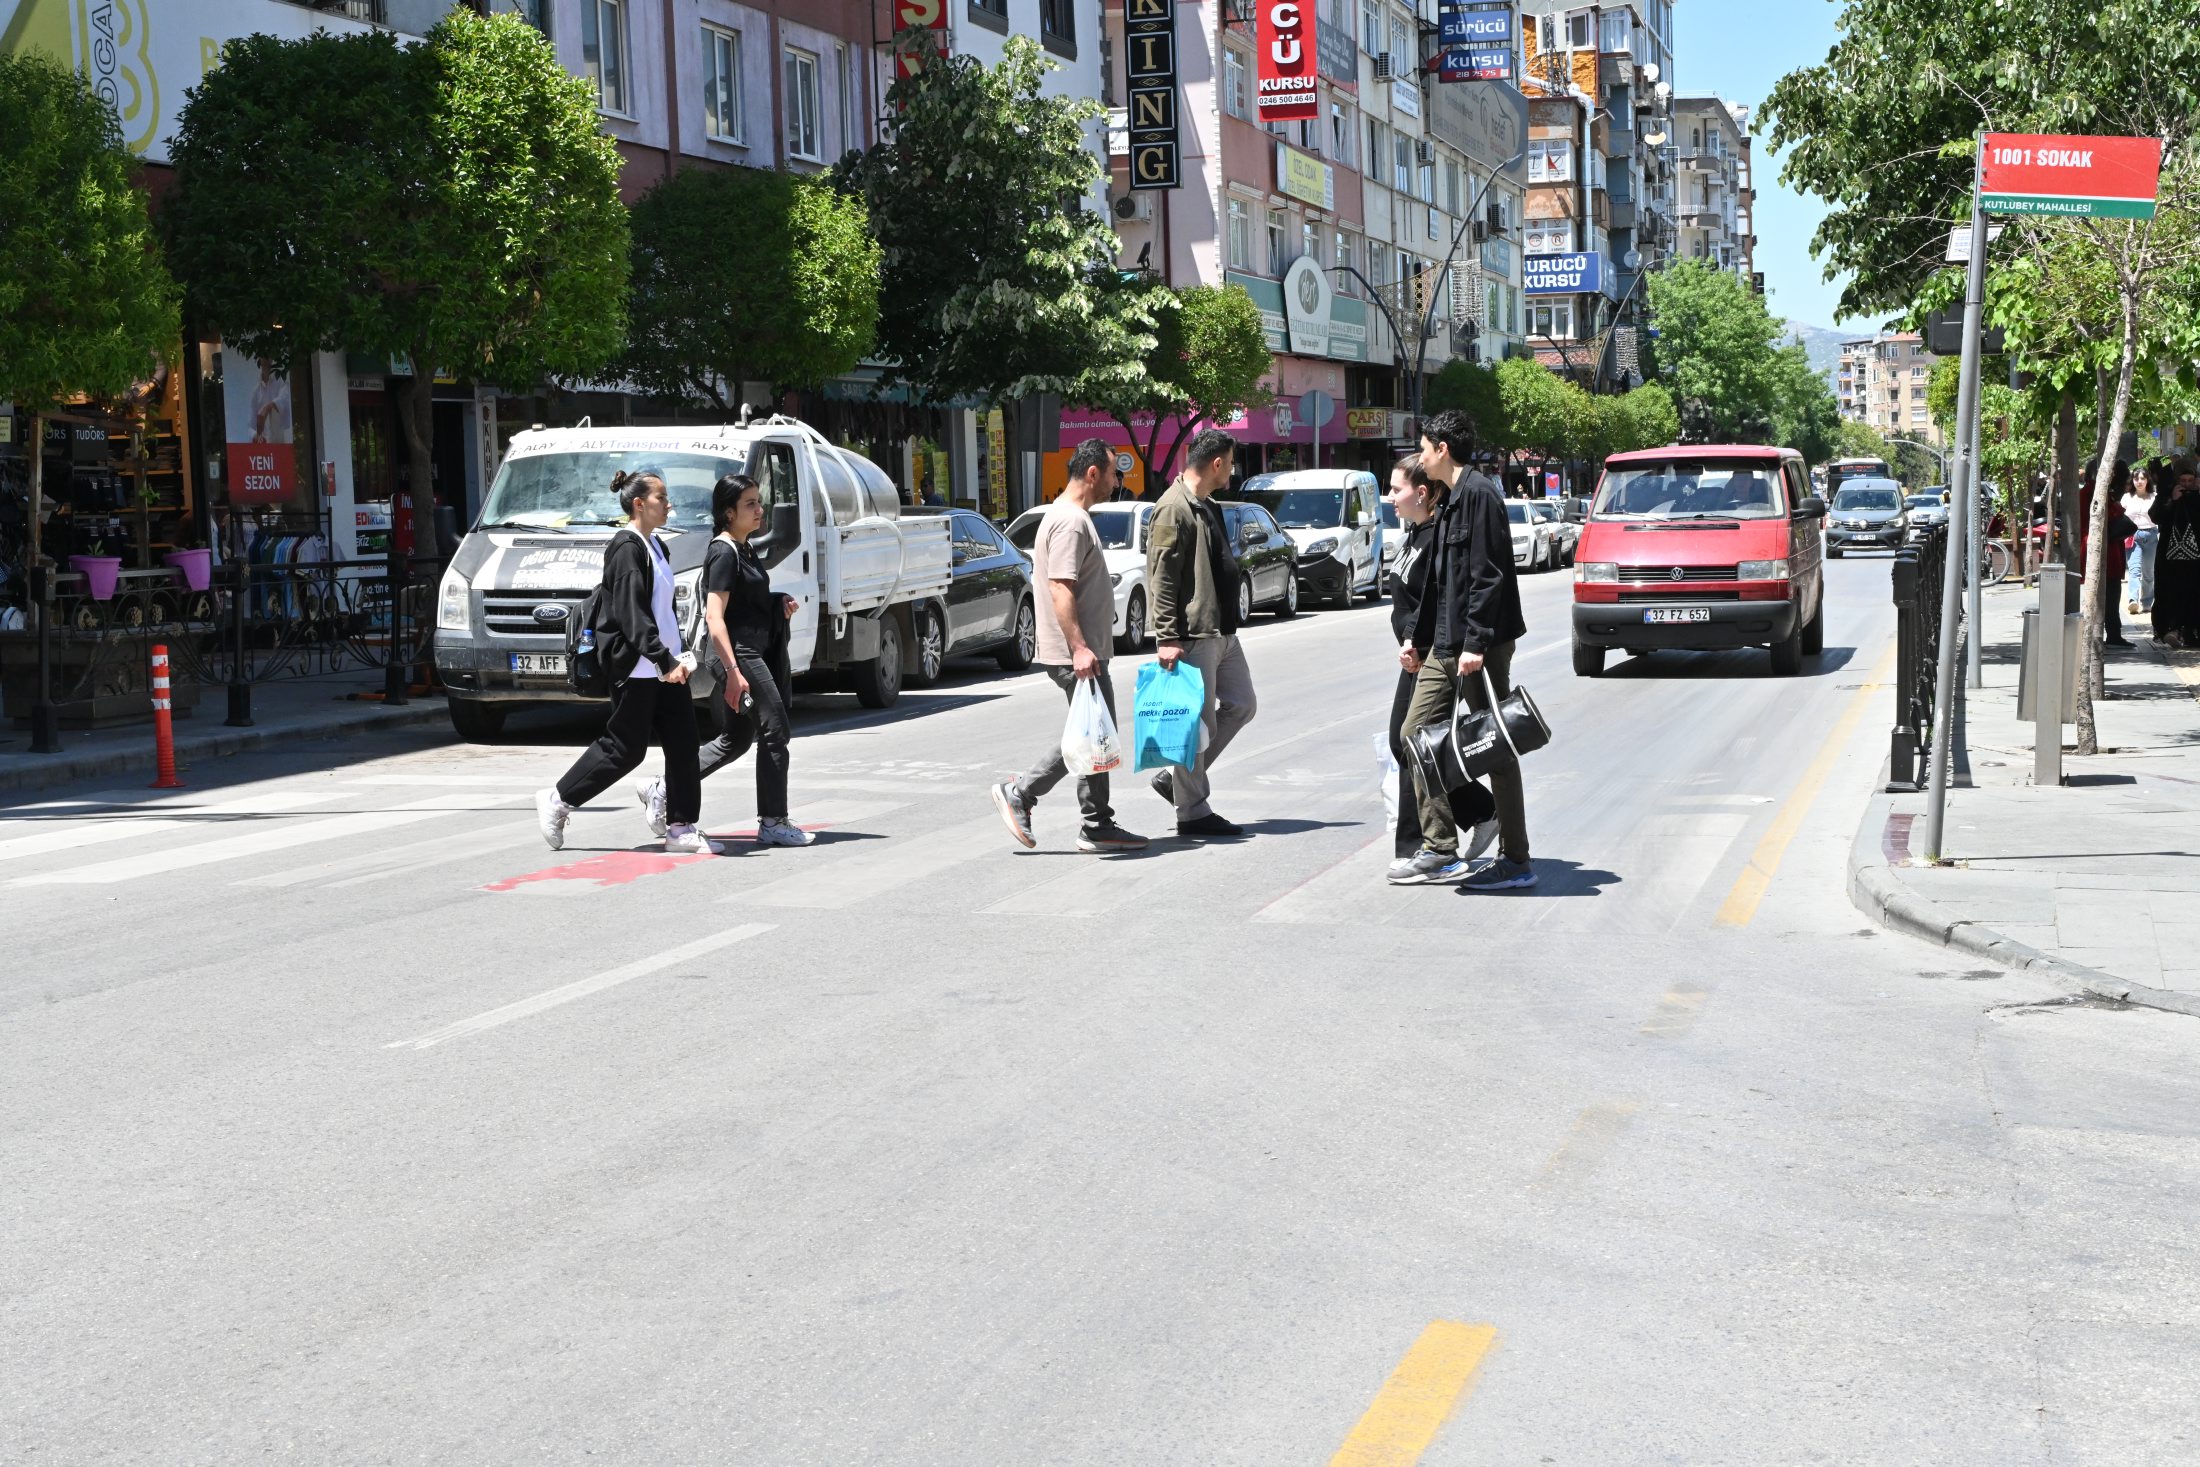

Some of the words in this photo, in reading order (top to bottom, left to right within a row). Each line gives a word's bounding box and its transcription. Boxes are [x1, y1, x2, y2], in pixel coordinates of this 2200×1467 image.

[1445, 18, 1505, 35] sürücü
[1447, 54, 1504, 68] kursu
[1259, 76, 1315, 91] KURSU
[1993, 148, 2030, 166] 1001
[2037, 149, 2093, 168] SOKAK
[1984, 201, 2034, 211] KUTLUBEY
[2036, 202, 2092, 213] MAHALLESİ
[1524, 255, 1587, 273] ÜRÜCÜ
[1525, 273, 1581, 288] KURSU
[24, 428, 66, 440] TORS
[75, 429, 105, 440] TUDORS
[524, 441, 557, 452] ALAY
[691, 441, 729, 452] ALAY
[249, 452, 275, 471] YENİ
[244, 475, 280, 490] SEZON
[540, 608, 560, 617] Ford
[1652, 610, 1665, 620] 32
[1671, 609, 1683, 620] FZ
[1689, 609, 1708, 620] 652
[517, 656, 532, 670] 32
[539, 656, 559, 670] AFF
